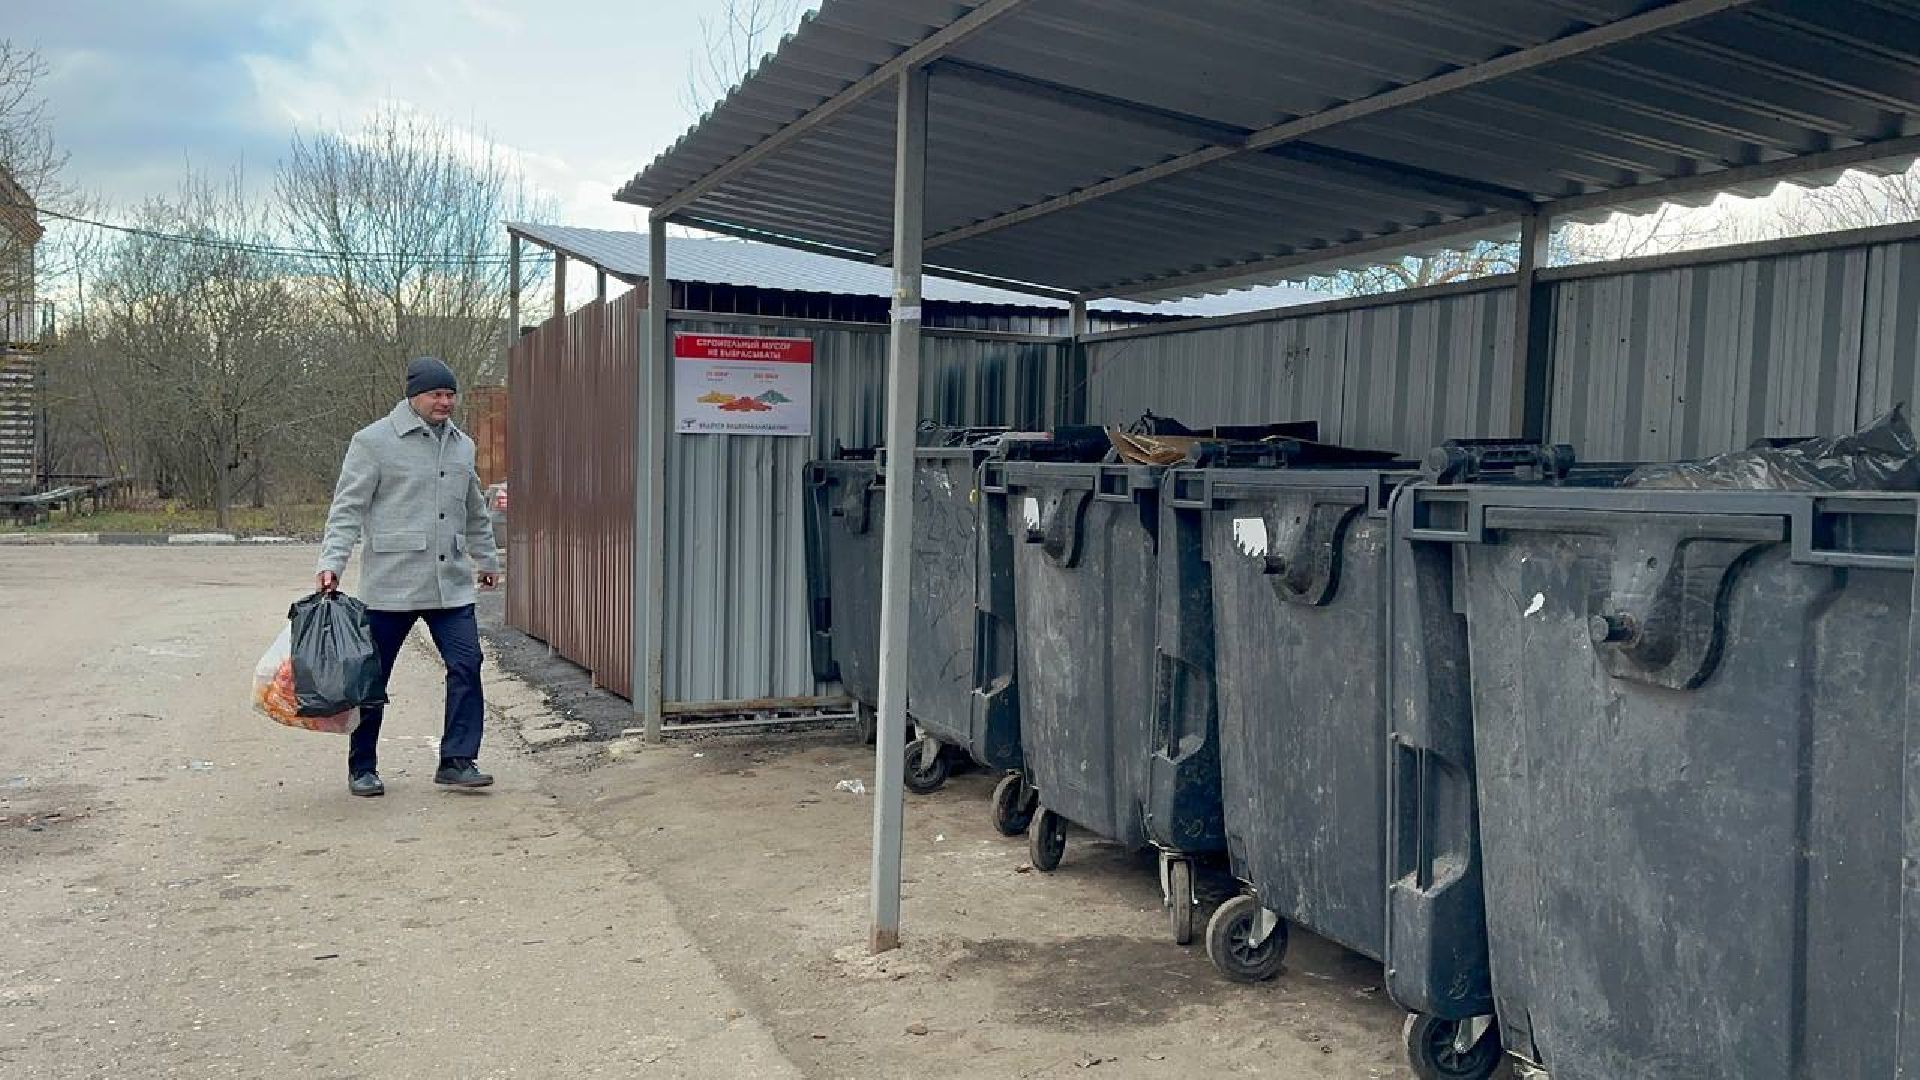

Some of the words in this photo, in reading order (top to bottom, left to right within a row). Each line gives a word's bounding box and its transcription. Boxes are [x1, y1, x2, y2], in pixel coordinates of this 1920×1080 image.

[696, 338, 760, 349] СТРОИТЕЛЬНЫЙ
[761, 340, 791, 350] МУСОР
[707, 348, 718, 356] НЕ
